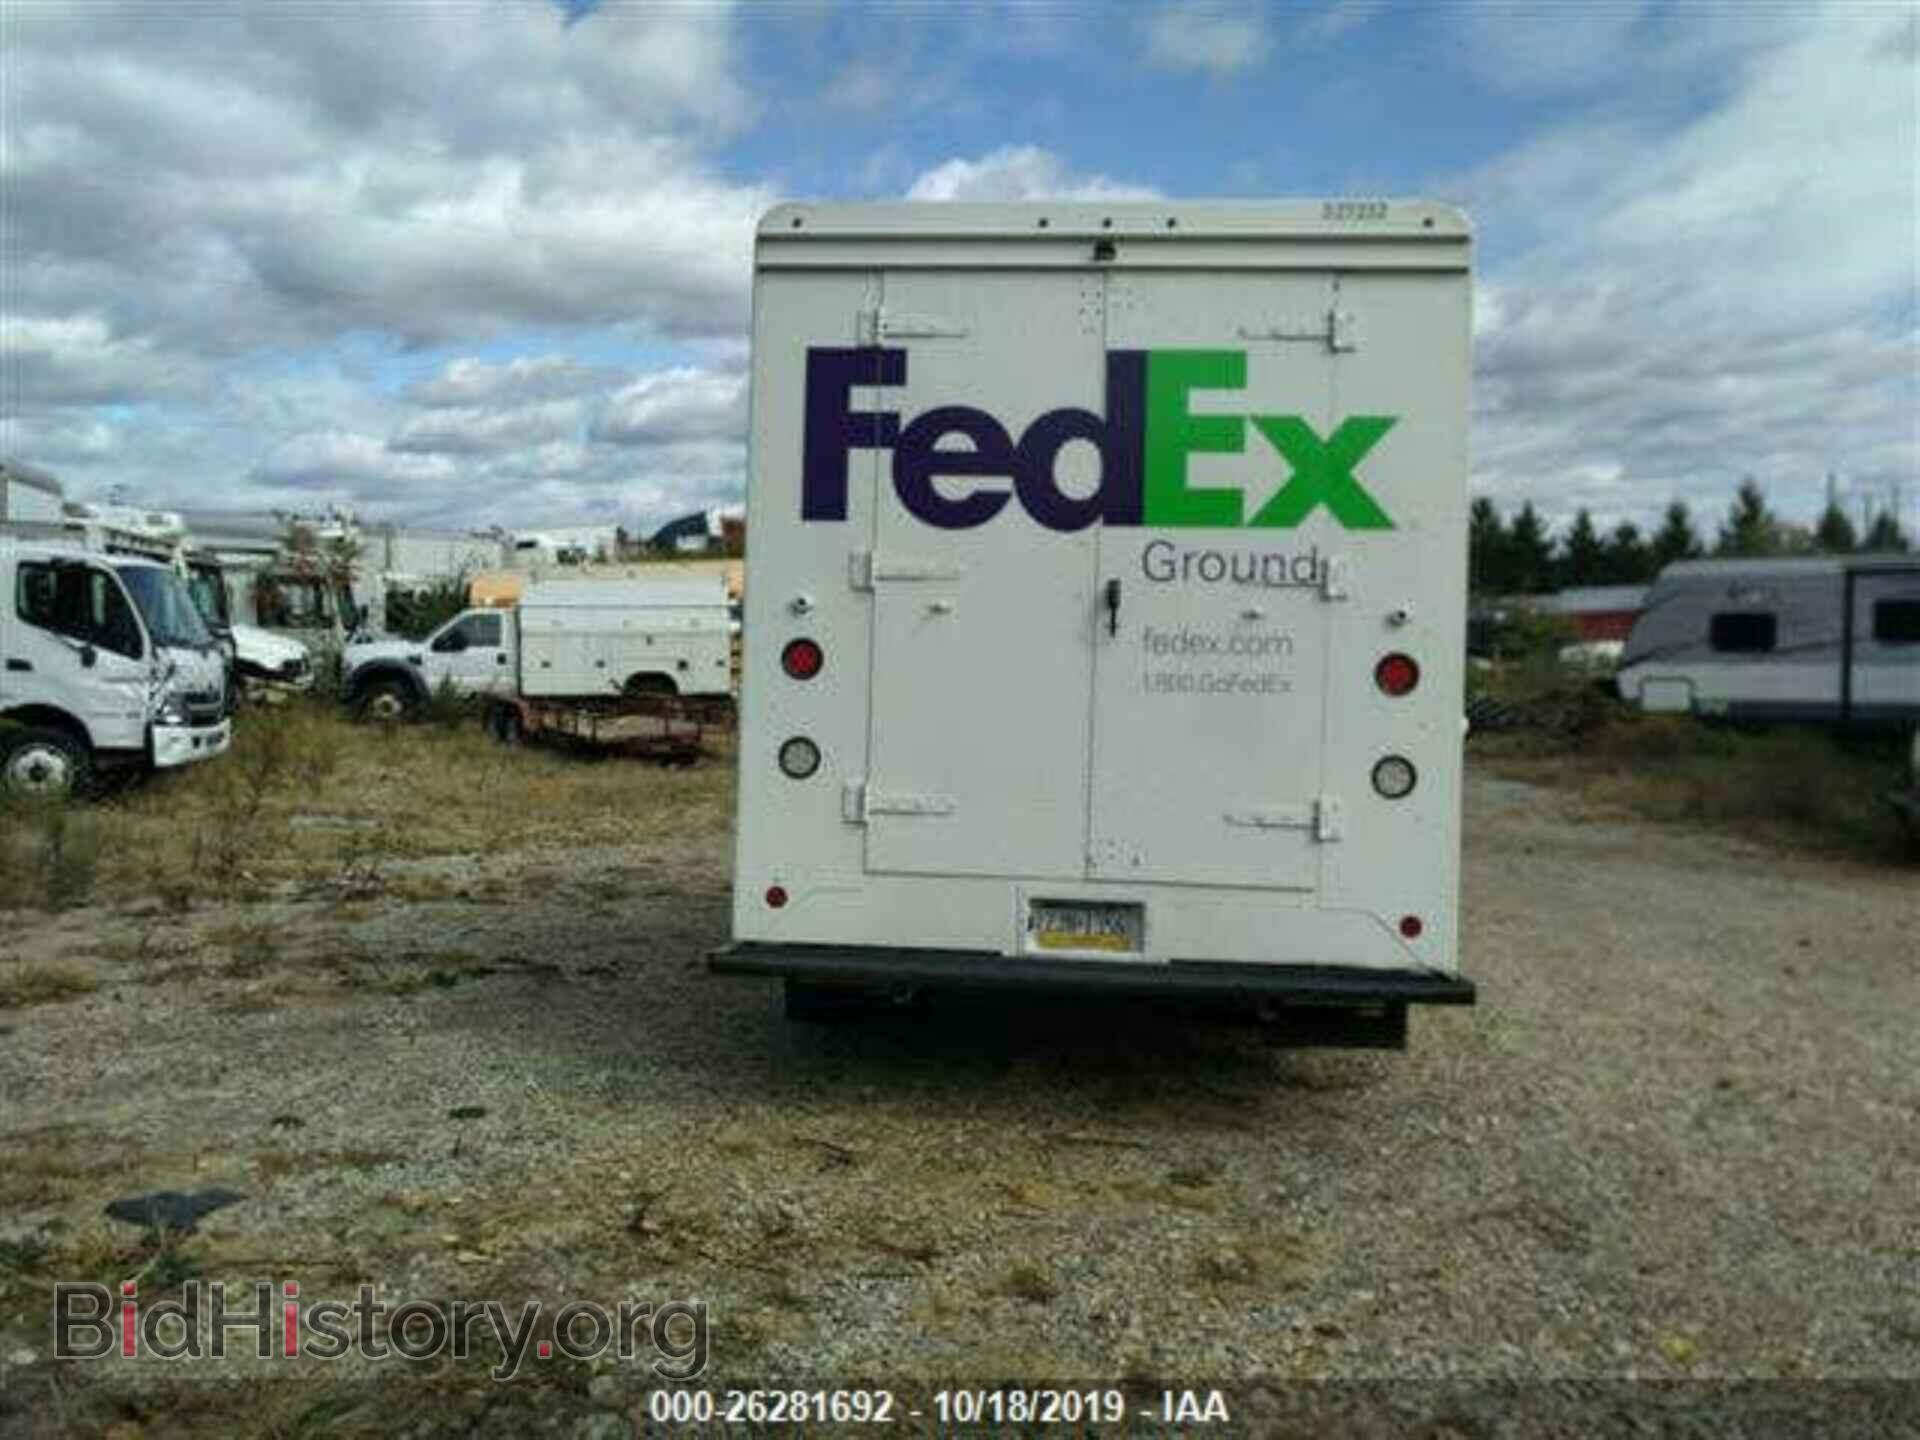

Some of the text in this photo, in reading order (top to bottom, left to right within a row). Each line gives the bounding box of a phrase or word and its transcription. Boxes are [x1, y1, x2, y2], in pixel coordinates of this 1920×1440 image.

[802, 346, 1398, 532] FedEx
[1142, 539, 1317, 584] Ground
[1142, 625, 1293, 656] fedex.com
